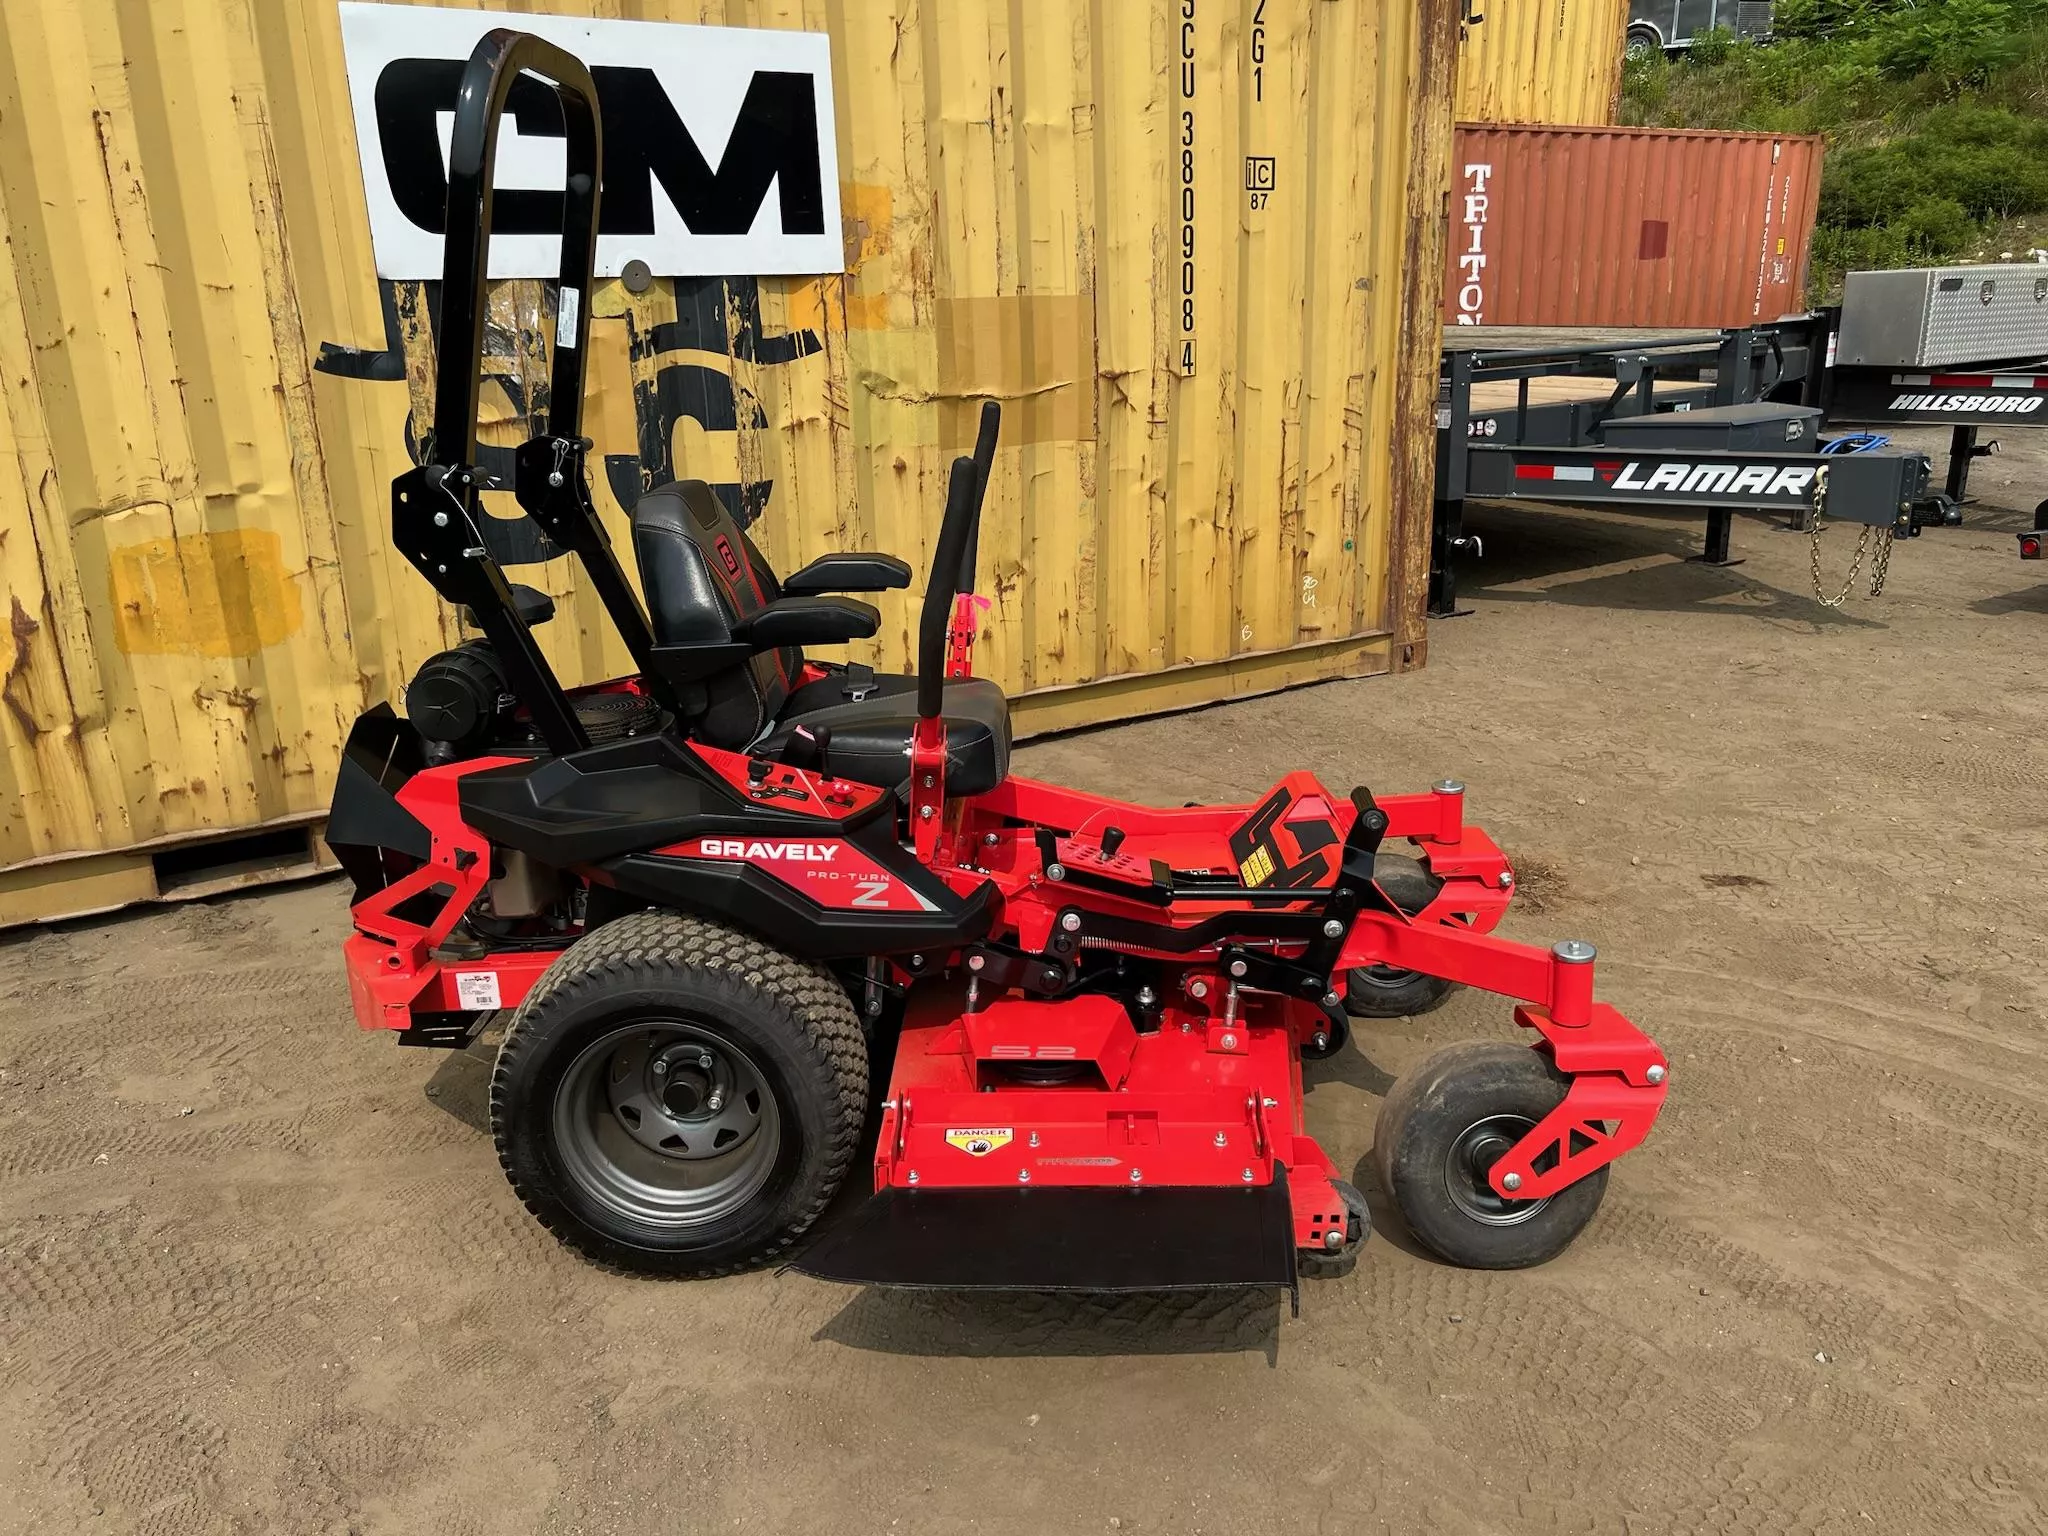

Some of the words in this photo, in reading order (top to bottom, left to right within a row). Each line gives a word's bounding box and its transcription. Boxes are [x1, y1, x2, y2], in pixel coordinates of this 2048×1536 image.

[1250, 193, 1268, 210] 87
[1181, 111, 1195, 332] 380908
[1182, 342, 1194, 375] 4
[1888, 394, 2044, 413] HILLSBORO
[1611, 462, 1817, 495] LAMAR
[701, 839, 839, 862] GRAVELY
[807, 870, 890, 881] PRO-TURN
[851, 882, 889, 907] Z
